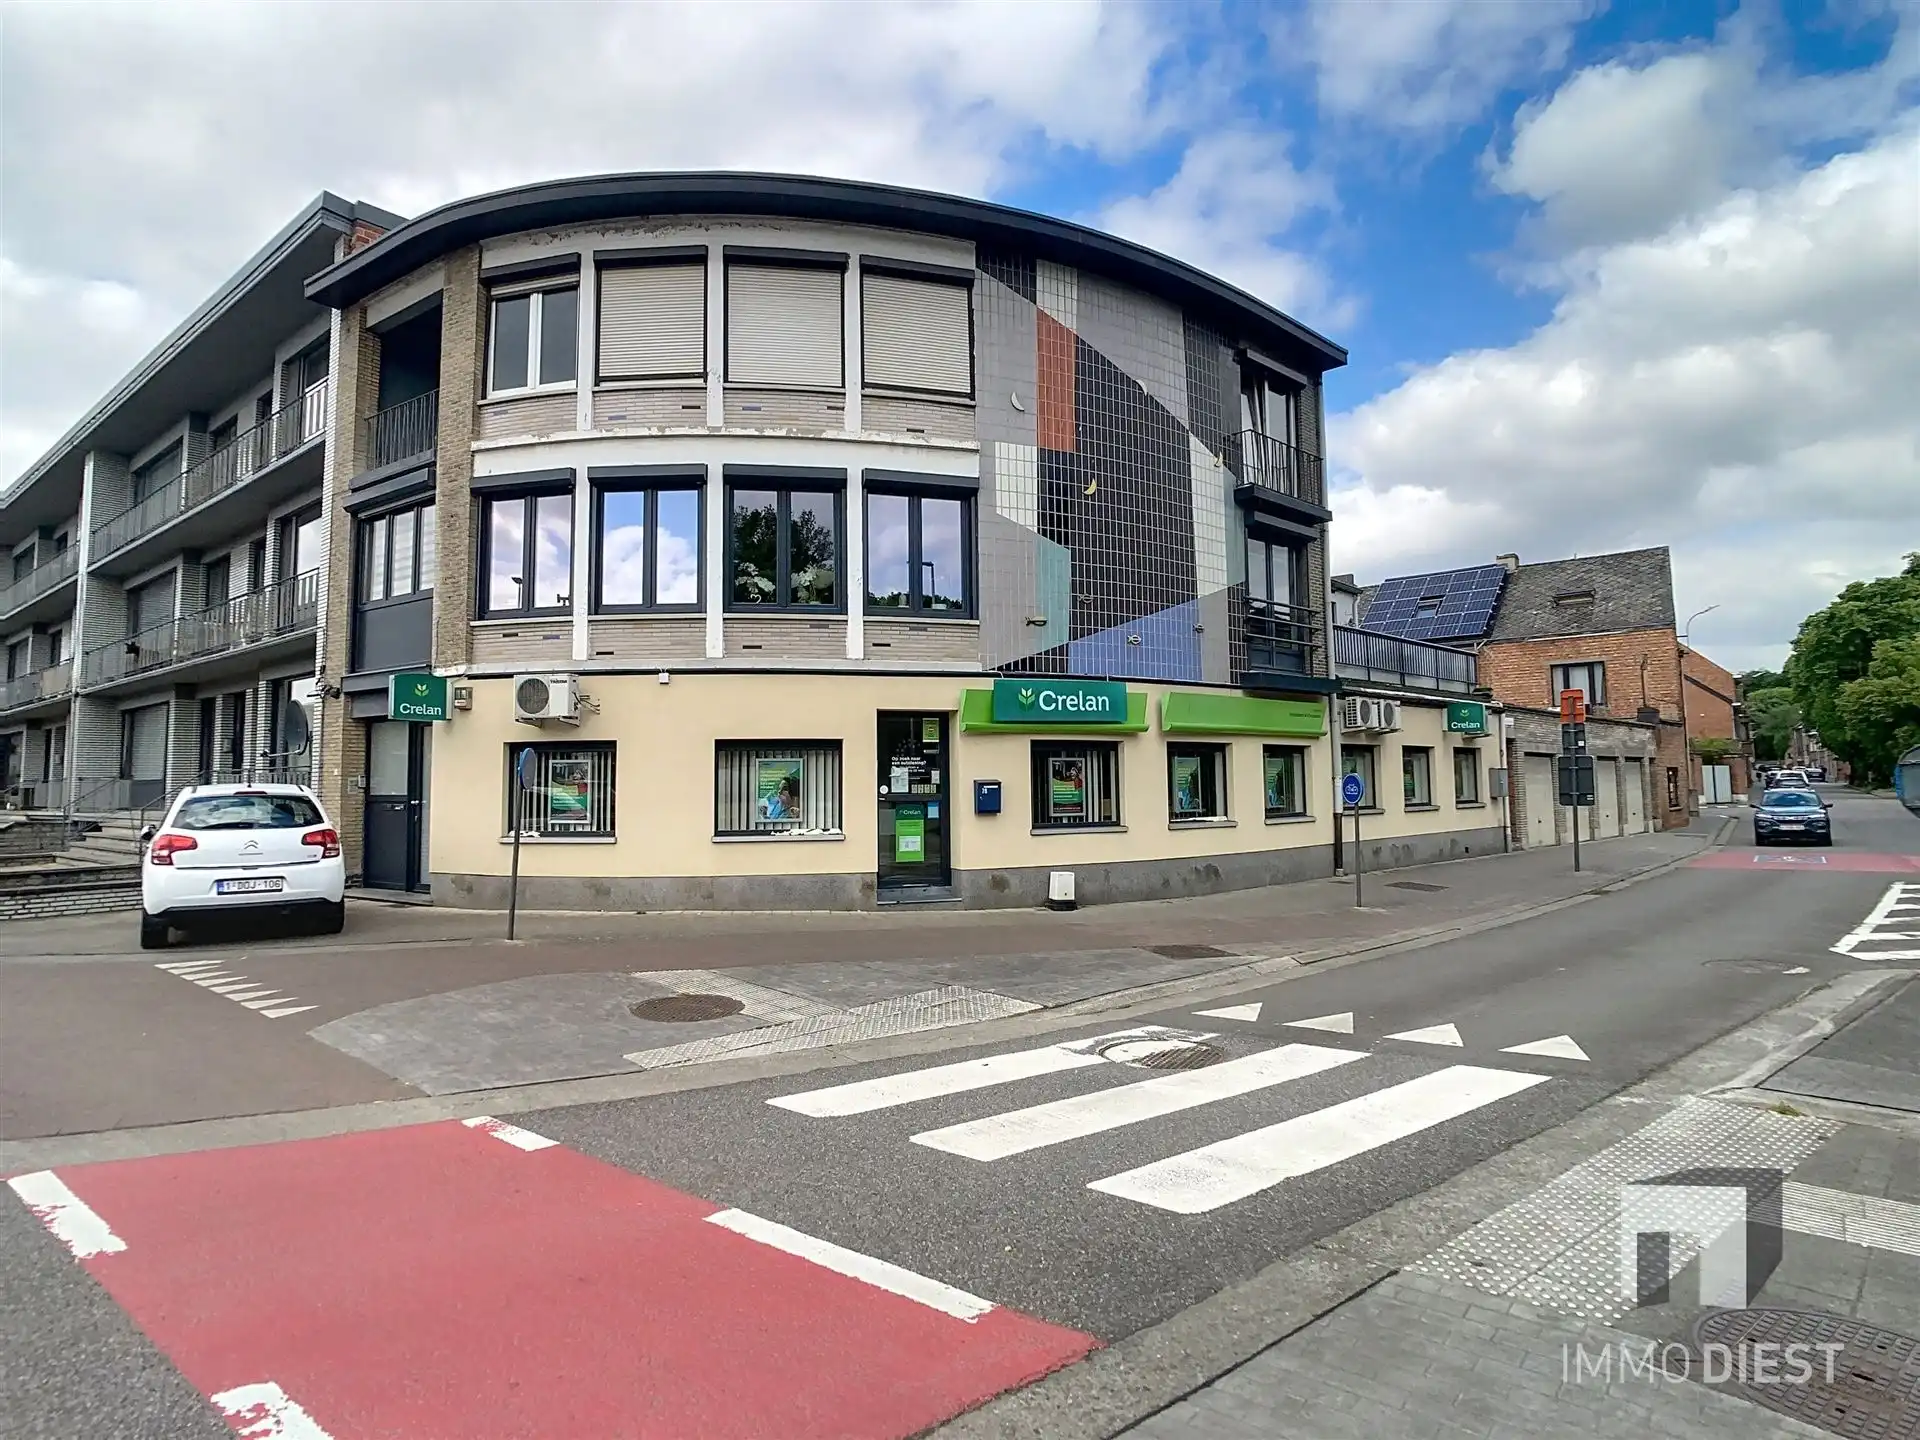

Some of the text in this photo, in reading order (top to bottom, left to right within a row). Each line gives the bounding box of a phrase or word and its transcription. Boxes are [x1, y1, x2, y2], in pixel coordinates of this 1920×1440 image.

[1038, 690, 1110, 711] Crelan
[400, 703, 442, 716] Crelan
[1451, 721, 1481, 729] Crelan
